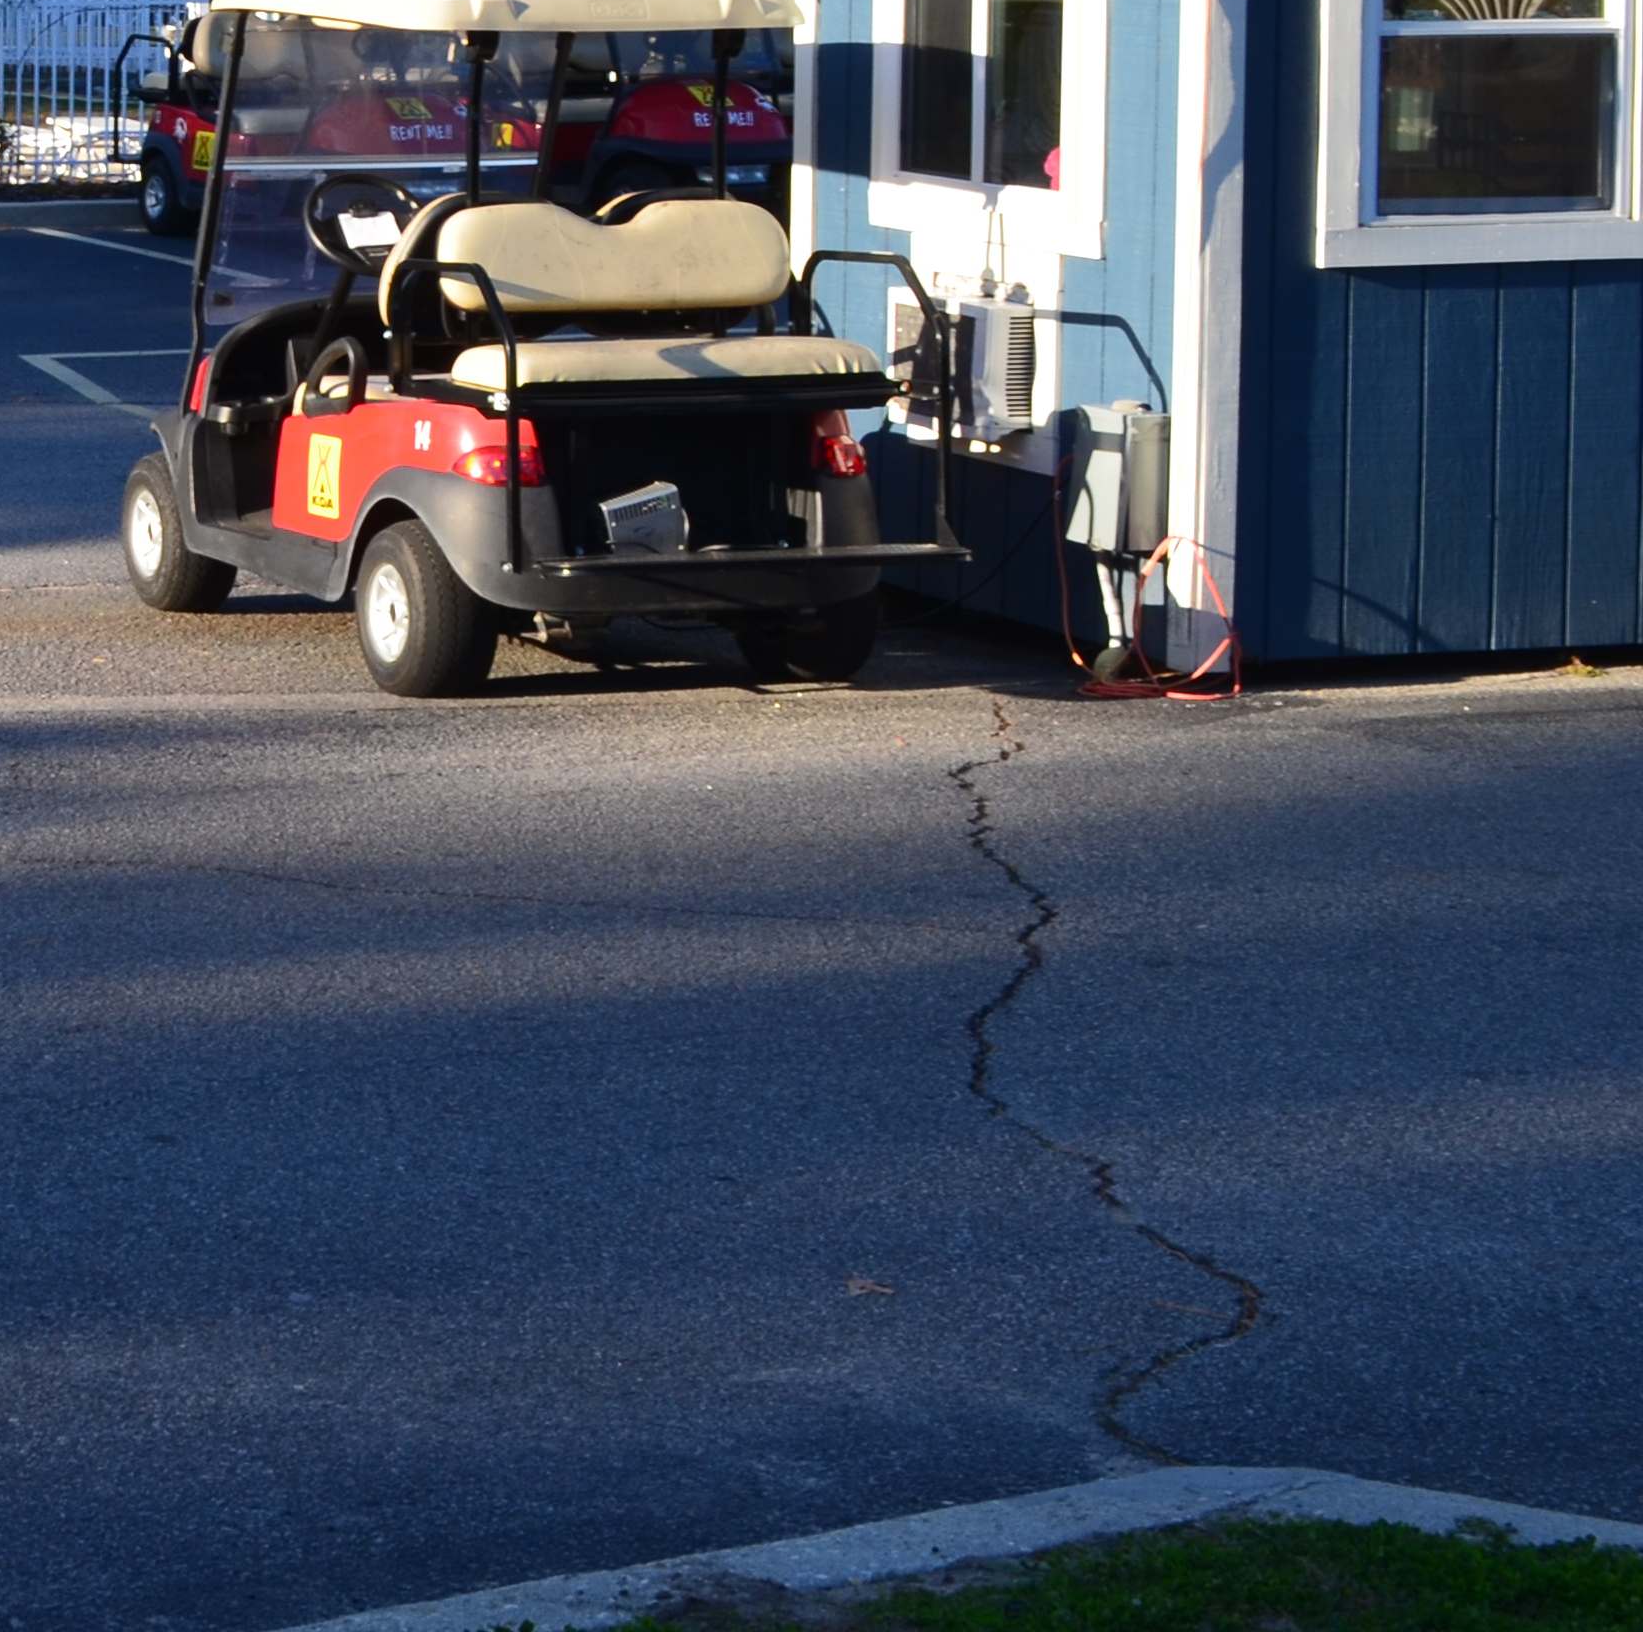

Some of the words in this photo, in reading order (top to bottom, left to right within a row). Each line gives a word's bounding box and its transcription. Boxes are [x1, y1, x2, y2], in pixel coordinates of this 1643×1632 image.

[727, 111, 754, 127] ME!!
[389, 124, 422, 141] RENT
[426, 124, 453, 140] ME!!
[415, 420, 431, 451] 14
[312, 495, 334, 509] KOA
